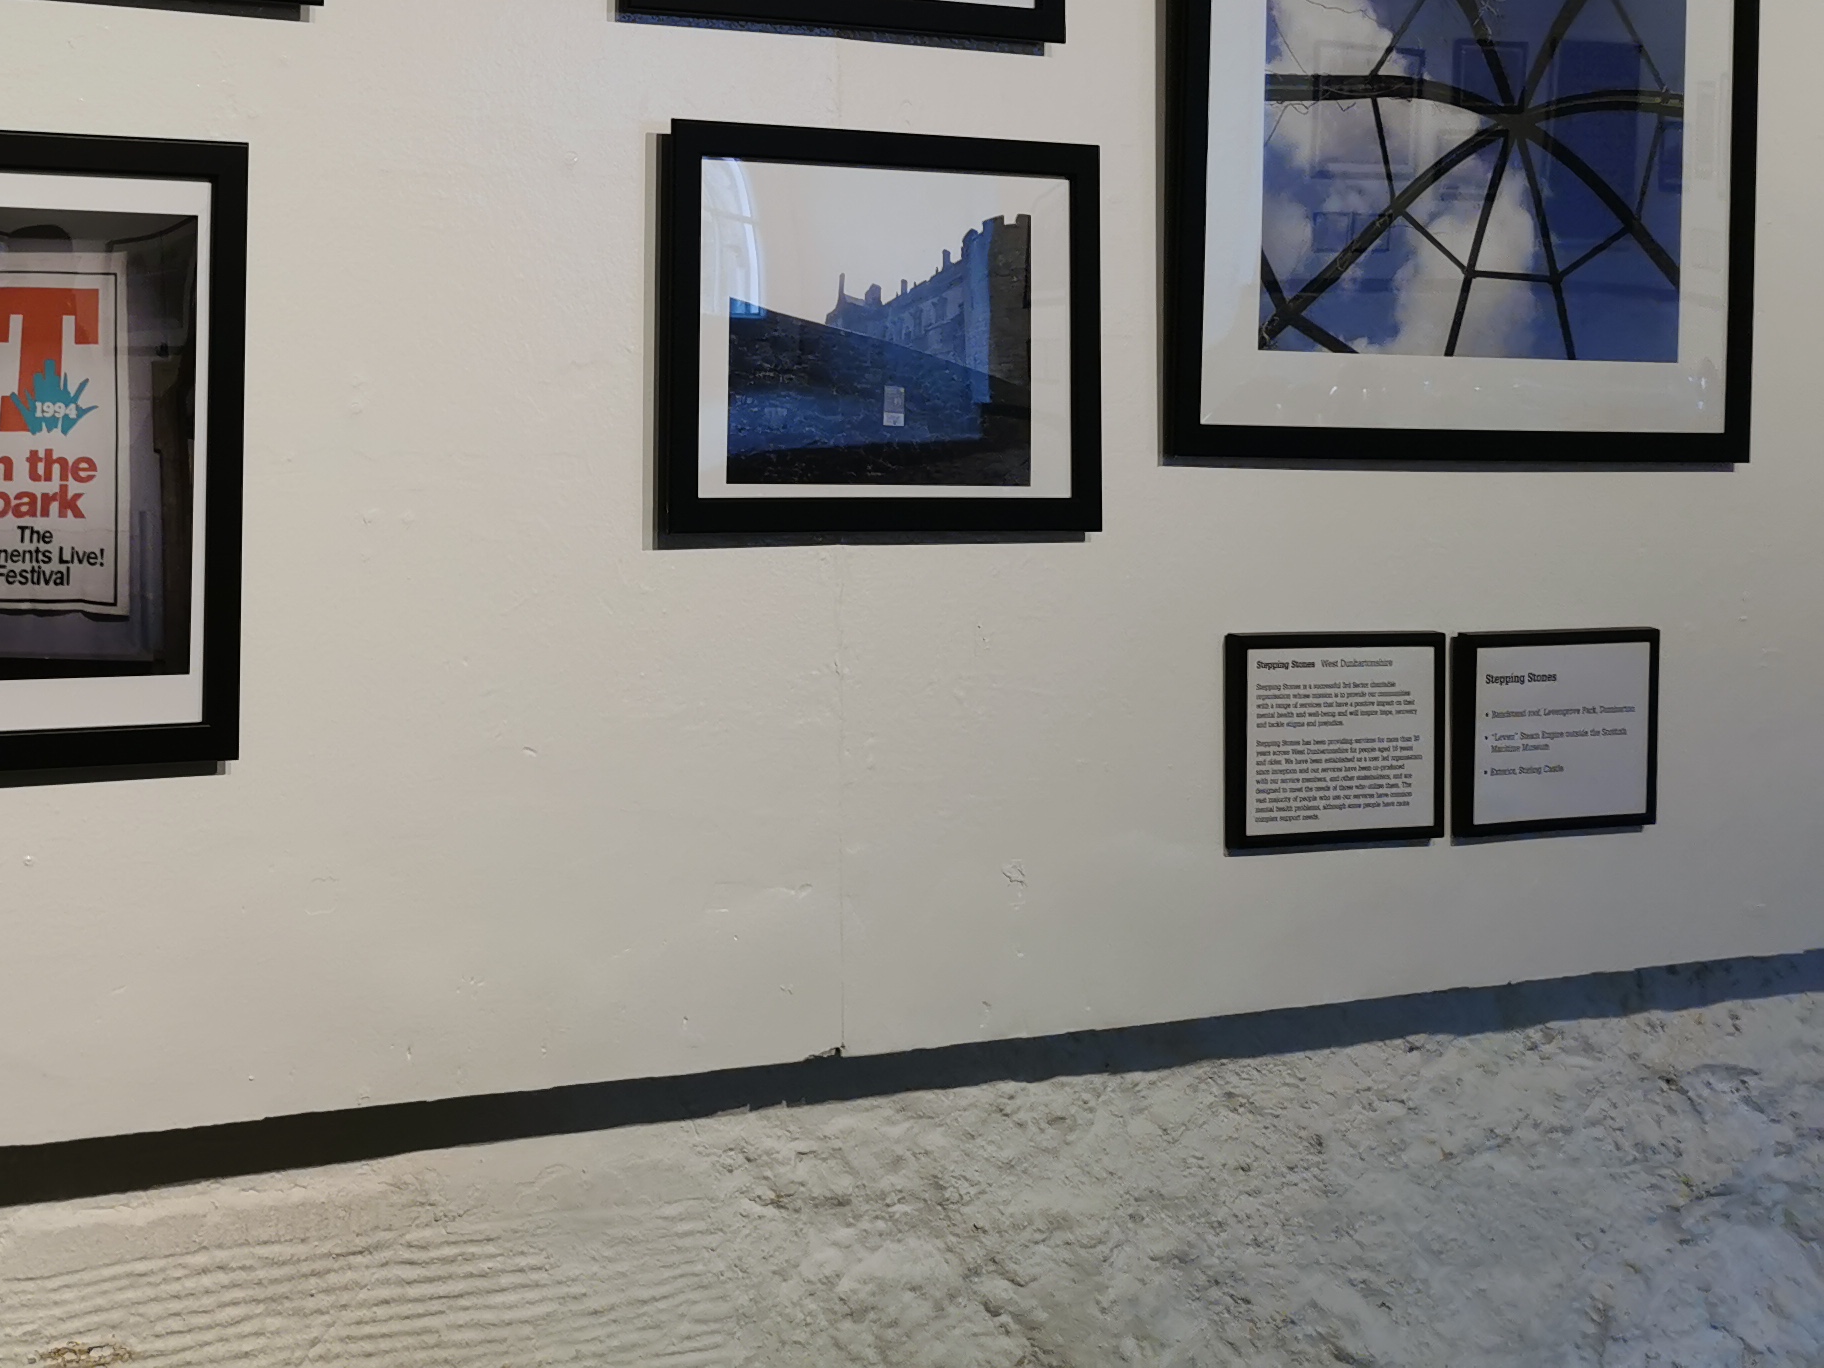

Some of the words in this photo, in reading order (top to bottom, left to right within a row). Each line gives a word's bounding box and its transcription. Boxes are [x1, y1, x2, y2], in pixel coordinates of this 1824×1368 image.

[34, 400, 78, 420] 1994
[25, 448, 98, 484] the
[16, 526, 54, 545] The
[59, 545, 105, 567] Live!
[1257, 661, 1290, 670] Stepping
[1291, 660, 1315, 668] Stones
[1486, 674, 1525, 686] Stepping
[1528, 673, 1557, 682] Stones
